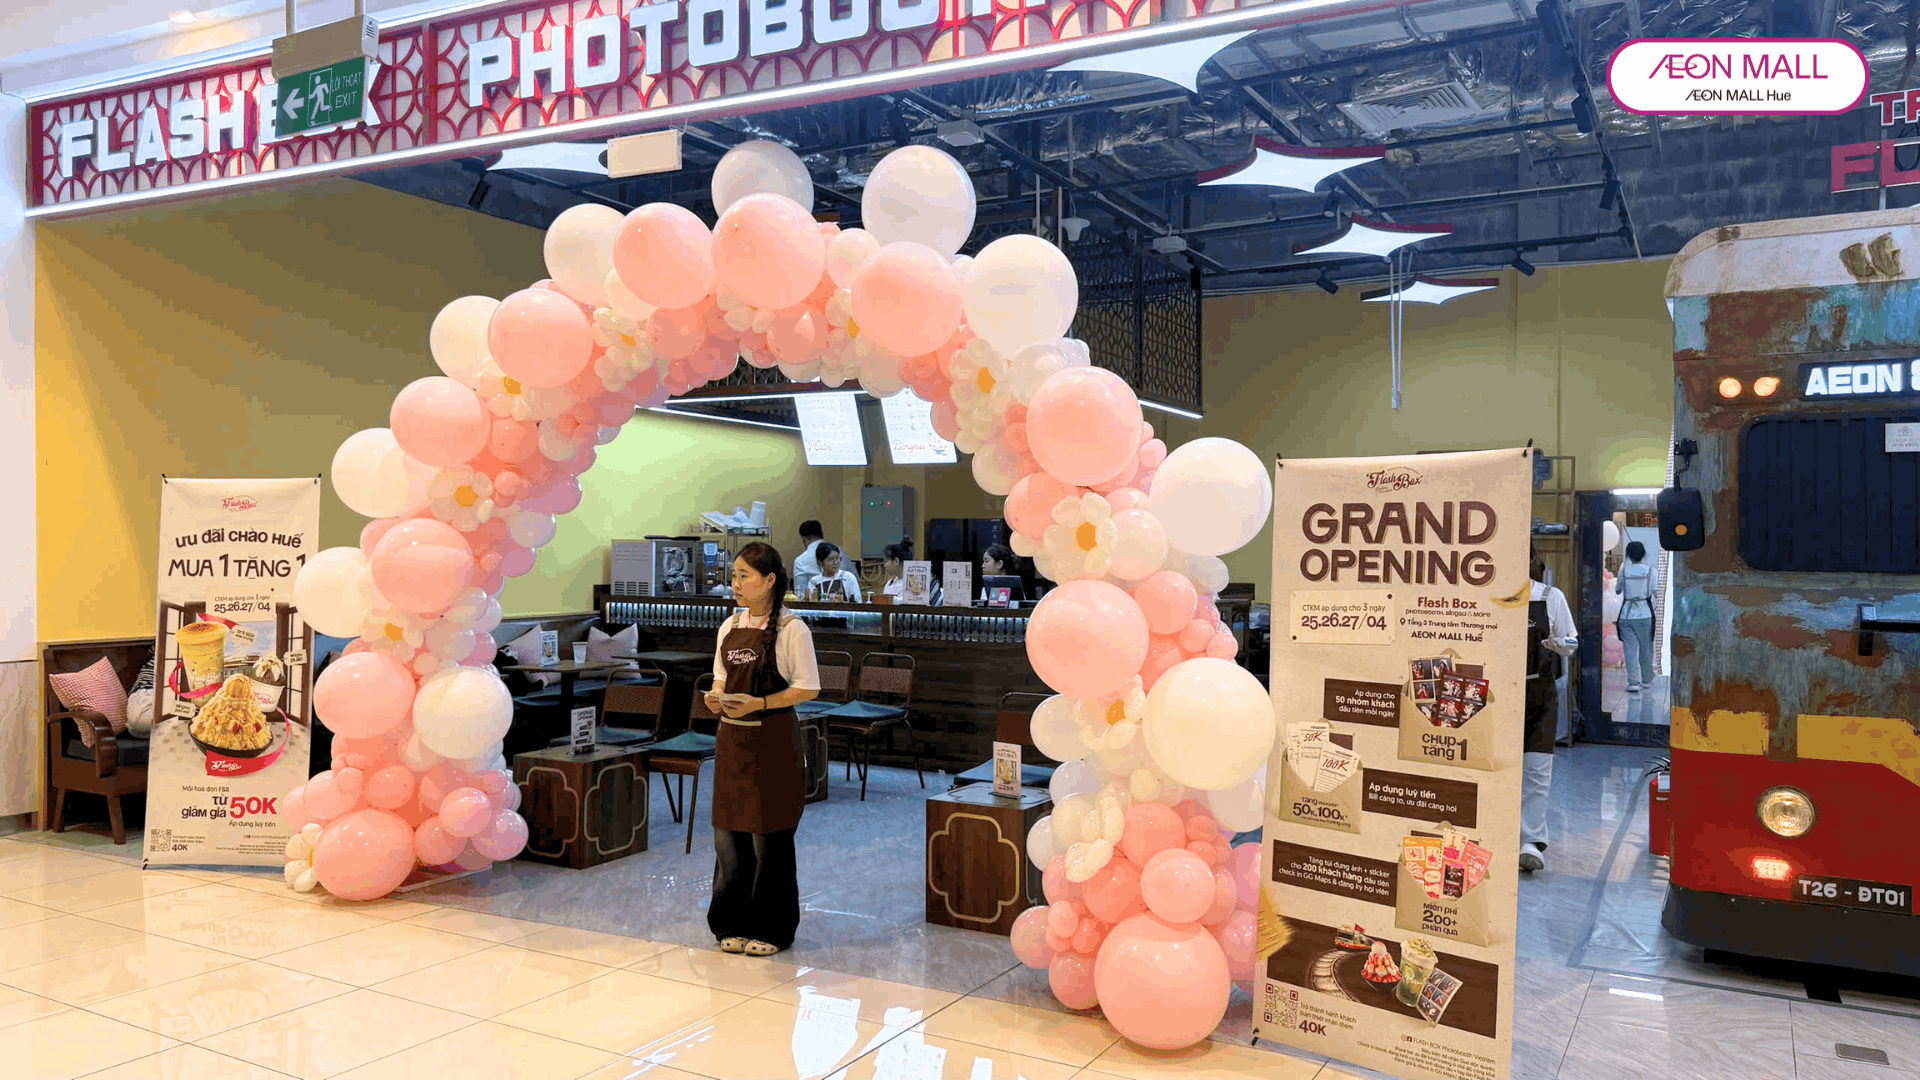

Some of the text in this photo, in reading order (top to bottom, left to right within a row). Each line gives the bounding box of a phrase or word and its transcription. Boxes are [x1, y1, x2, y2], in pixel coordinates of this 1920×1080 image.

[335, 91, 357, 108] EXIT
[61, 90, 247, 178] FLASH
[1804, 362, 1904, 396] AEON
[1367, 470, 1396, 489] Flash
[1393, 473, 1421, 491] Box
[1302, 501, 1498, 545] GRAND
[201, 528, 225, 543] đãi
[168, 559, 214, 577] MUA
[219, 553, 229, 577] 1
[1300, 548, 1495, 586] OPENING
[214, 601, 271, 614] 25.26.27/04
[1302, 604, 1320, 612] CTKM
[1362, 602, 1368, 611] 3
[1417, 596, 1477, 609] Flash Box
[1301, 612, 1387, 630] 25.26.27/04
[1428, 620, 1447, 628] Trung
[1411, 630, 1484, 642] AEON MALL Huế
[1335, 695, 1346, 704] 50
[1303, 731, 1323, 742] 50K
[1456, 738, 1468, 761] 1
[1322, 758, 1350, 772] 100K
[1368, 781, 1381, 792] Áp
[1382, 784, 1404, 797] dụng
[1419, 790, 1436, 799] tiến
[209, 806, 227, 819] giá
[229, 796, 278, 819] 50K
[1278, 867, 1296, 877] check
[1303, 872, 1314, 880] GG
[1314, 874, 1332, 885] Maps
[1290, 862, 1302, 870] cho
[1302, 863, 1317, 872] 200
[1342, 870, 1363, 883] hàng
[1369, 869, 1390, 878] sticker
[1799, 880, 1838, 899] T26
[1858, 887, 1905, 907] ĐT01
[1422, 909, 1458, 926] 200+
[1299, 1020, 1327, 1036] 40K
